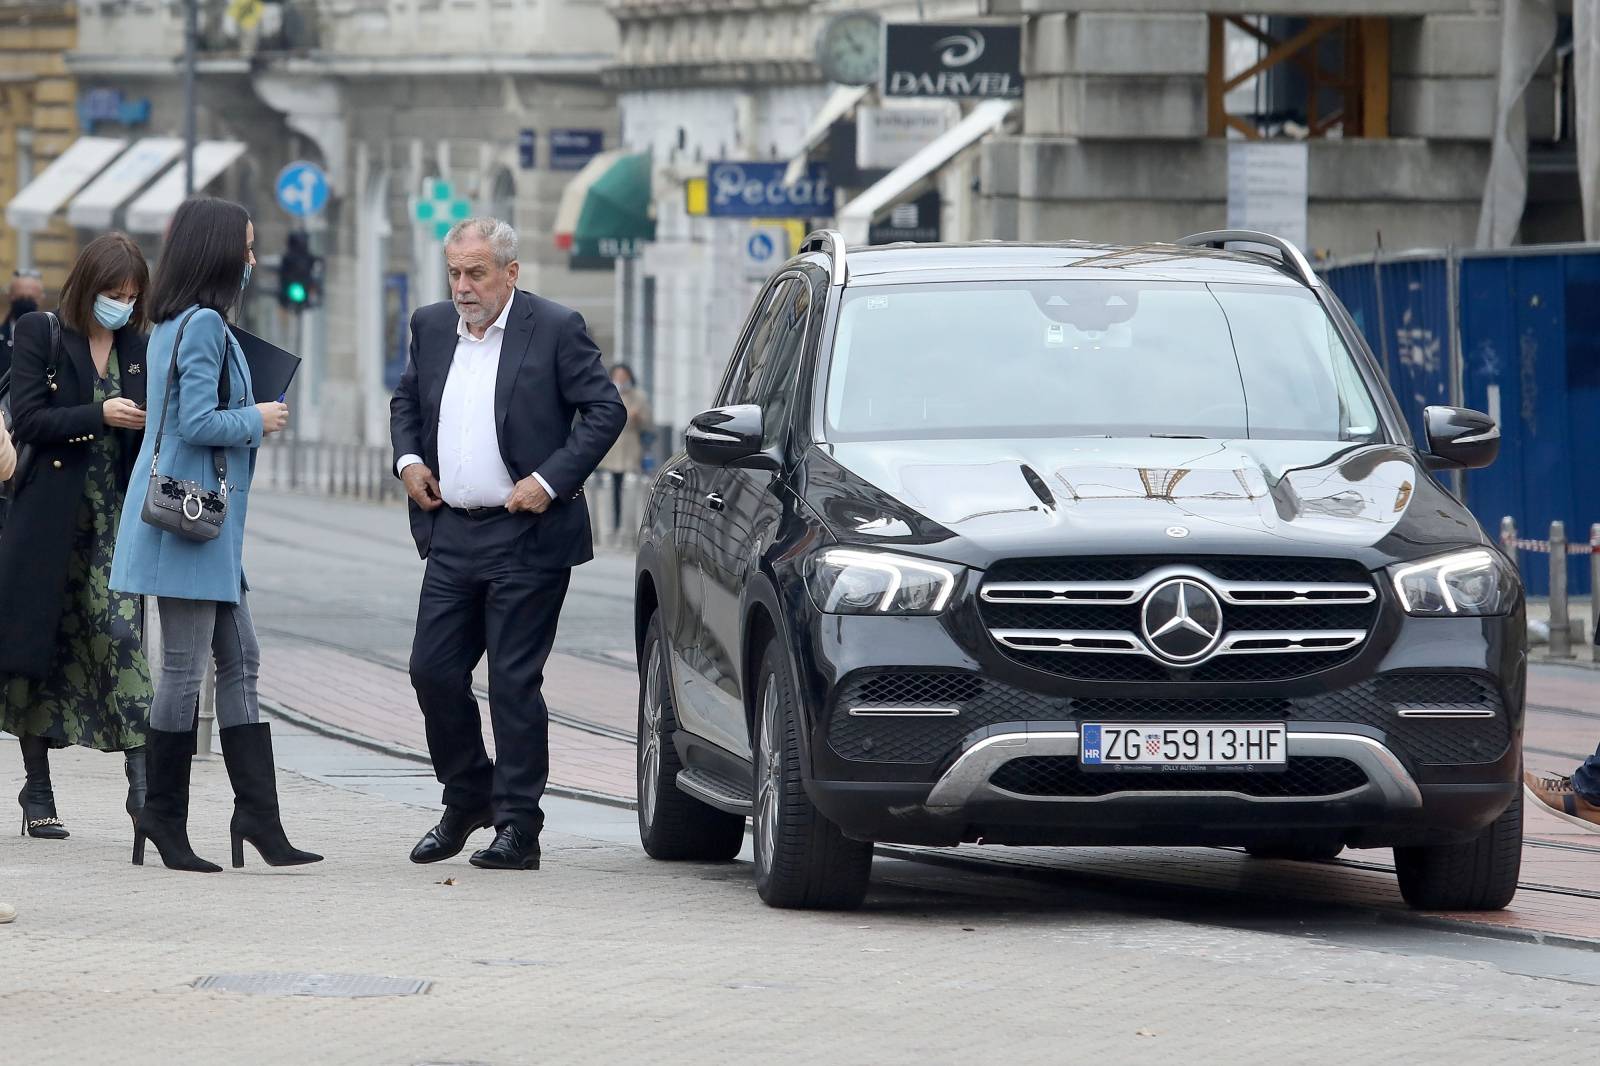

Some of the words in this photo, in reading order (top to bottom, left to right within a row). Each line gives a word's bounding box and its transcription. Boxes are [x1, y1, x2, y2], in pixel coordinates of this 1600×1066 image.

[890, 71, 1022, 96] DARVEL
[1104, 729, 1141, 760] ZG
[1084, 749, 1100, 759] HR
[1161, 764, 1179, 772] JOLLY
